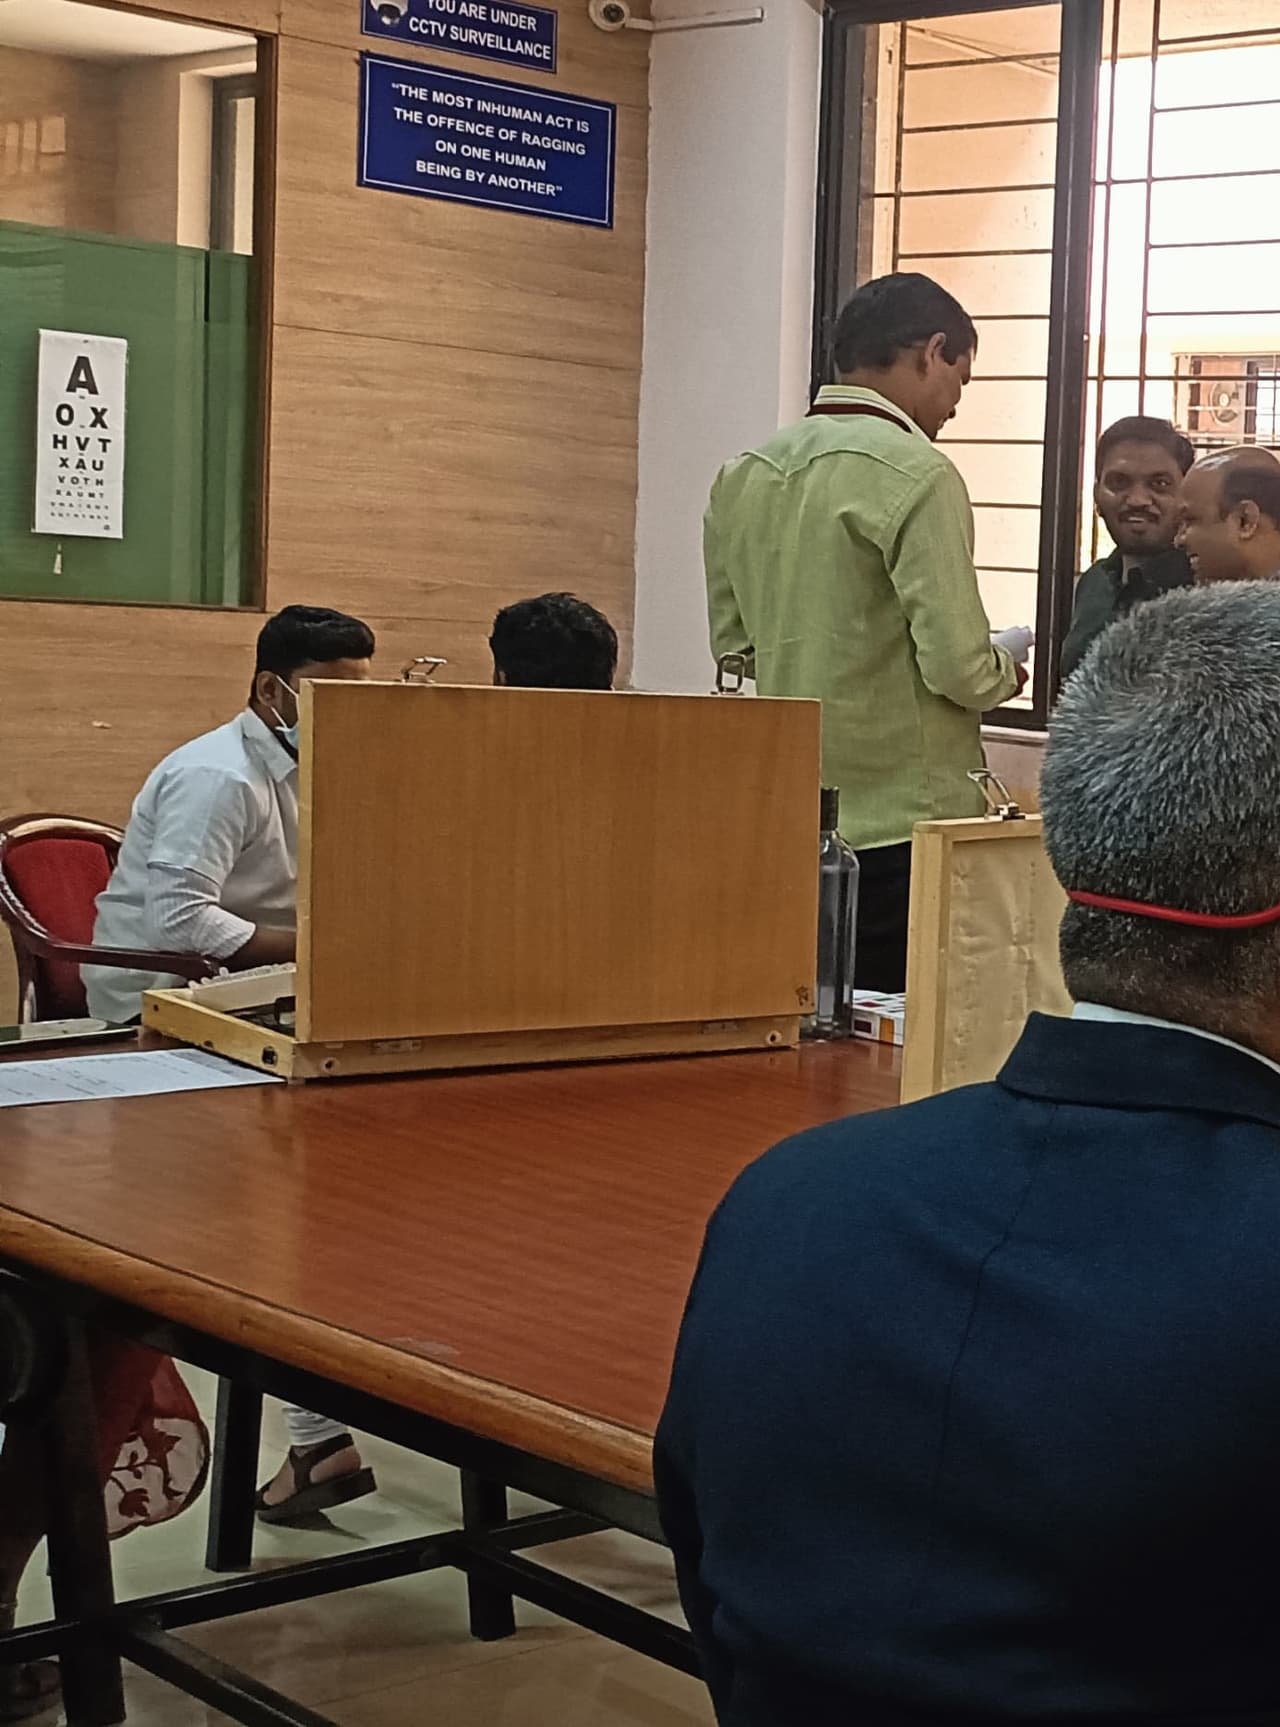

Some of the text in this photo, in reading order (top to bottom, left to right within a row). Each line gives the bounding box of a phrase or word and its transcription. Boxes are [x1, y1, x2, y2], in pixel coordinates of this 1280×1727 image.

[428, 0, 537, 31] YOU ARE UNDER
[409, 17, 551, 60] CCTV SURVEILLANCE
[432, 91, 474, 109] MOST
[477, 100, 542, 123] INHUMAN
[545, 115, 574, 130] ACT
[576, 121, 590, 133] IS
[393, 107, 586, 155] THE OFFENCE OF RAGGING
[435, 140, 546, 171] ON ONE HUMAN
[416, 160, 462, 179] BEING
[465, 169, 485, 183] BY
[66, 356, 99, 395] A
[55, 403, 108, 429] O X
[53, 434, 111, 453] H V T
[59, 457, 104, 471] X A U
